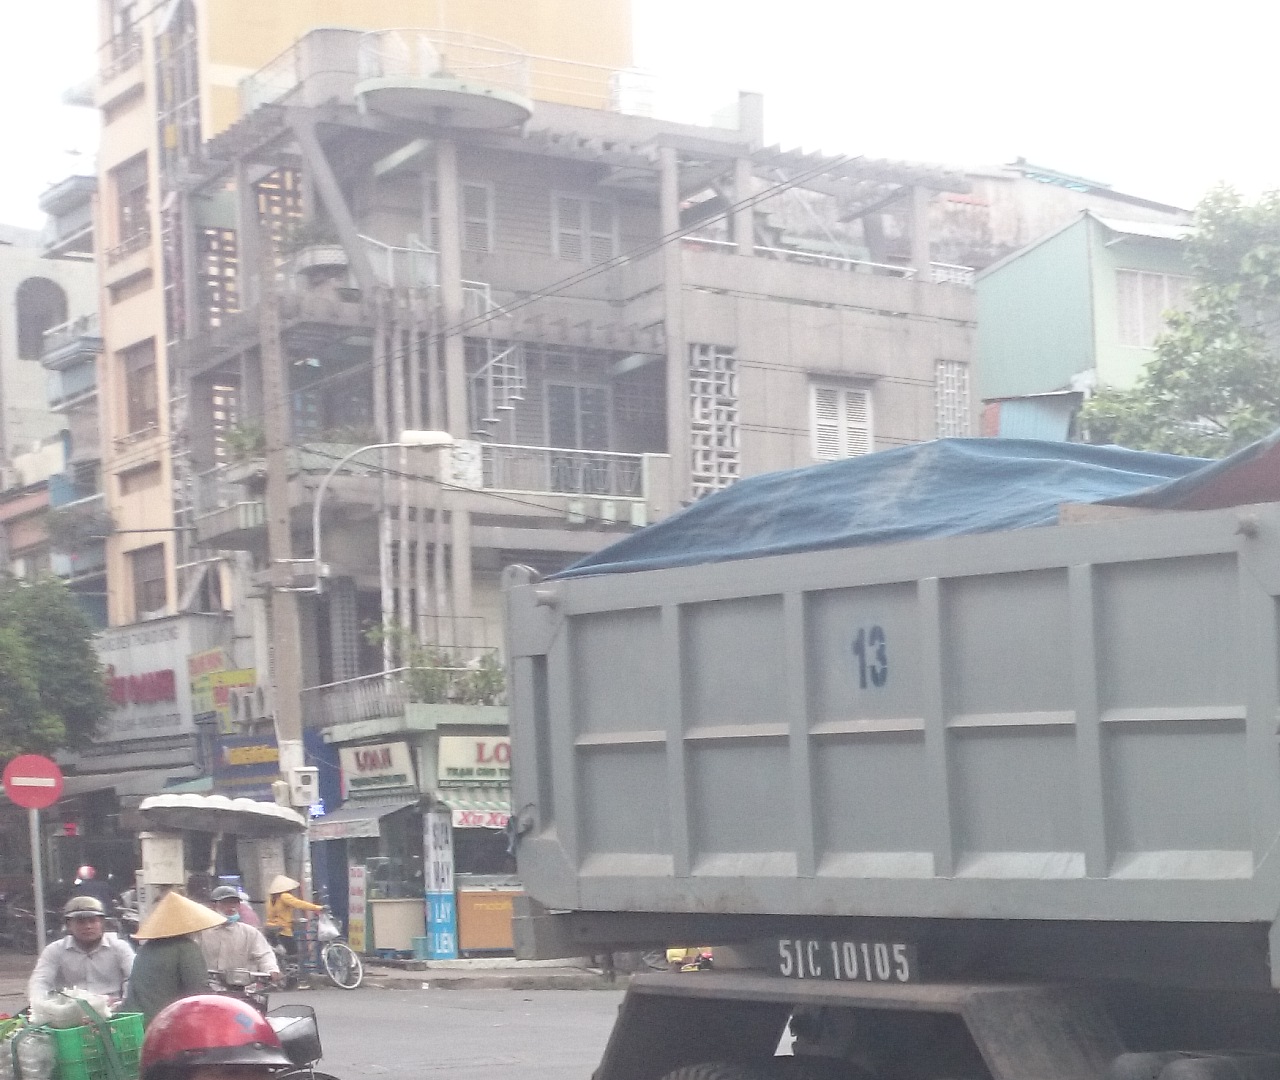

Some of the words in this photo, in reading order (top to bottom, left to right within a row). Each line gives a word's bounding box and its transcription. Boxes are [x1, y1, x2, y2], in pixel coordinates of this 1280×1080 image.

[851, 626, 888, 690] 13
[778, 939, 822, 979] 51C
[830, 941, 910, 982] 10105
